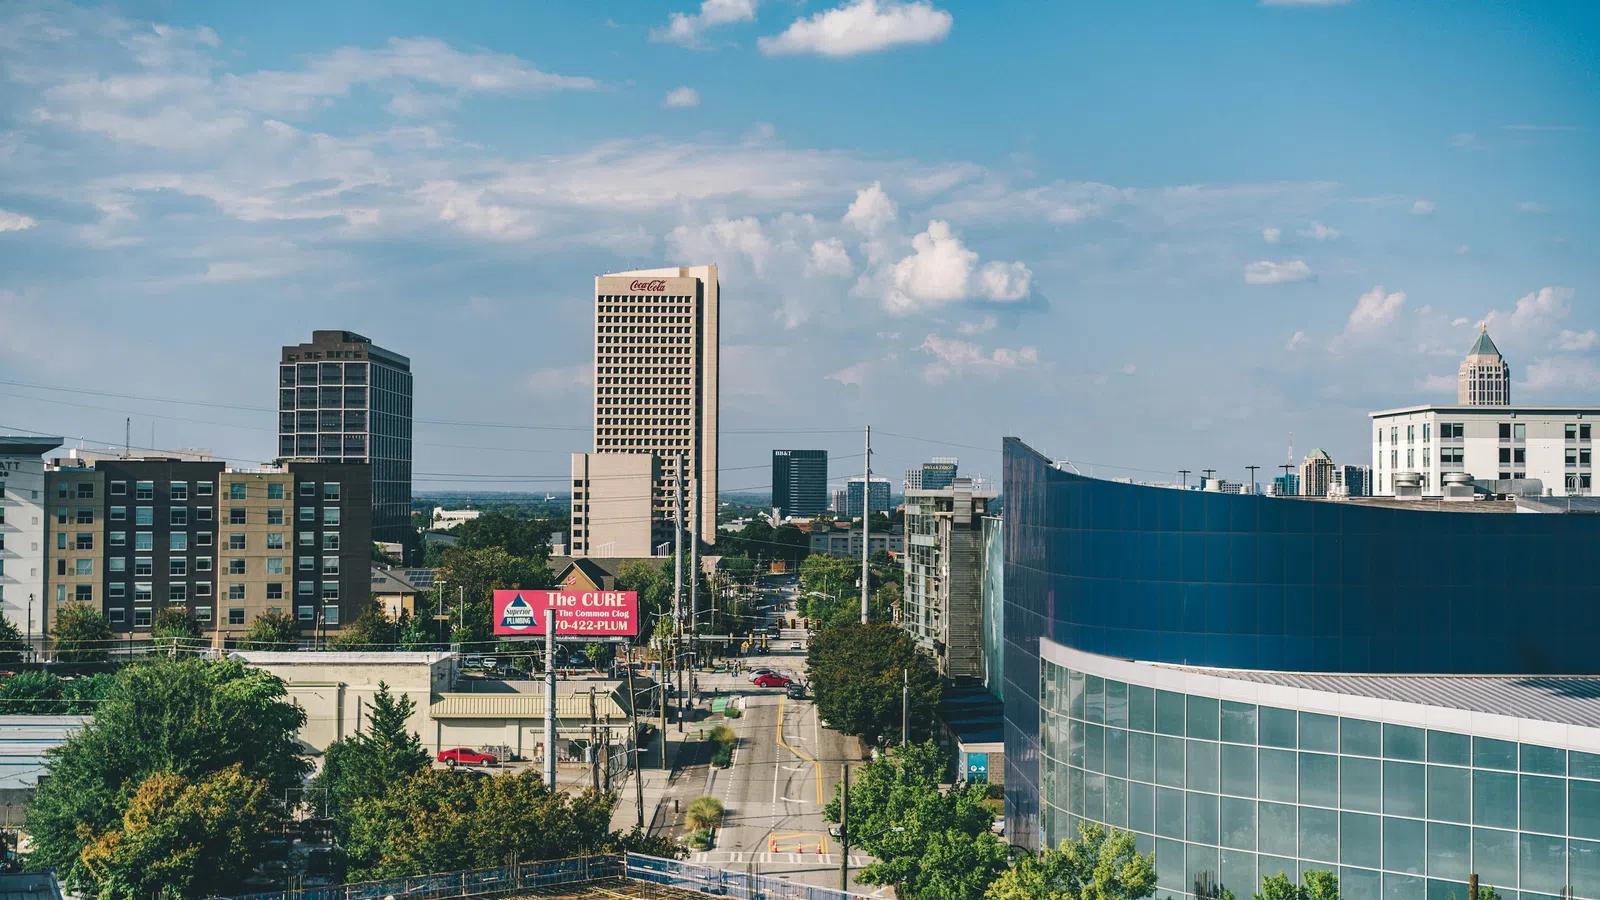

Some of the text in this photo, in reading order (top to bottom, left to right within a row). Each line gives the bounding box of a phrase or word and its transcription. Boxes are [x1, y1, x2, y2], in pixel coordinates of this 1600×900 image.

[546, 592, 626, 606] The CURE
[506, 608, 532, 616] Superior
[575, 610, 610, 618] Common
[612, 610, 630, 618] Clog
[555, 620, 628, 630] 70-422-PLUM
